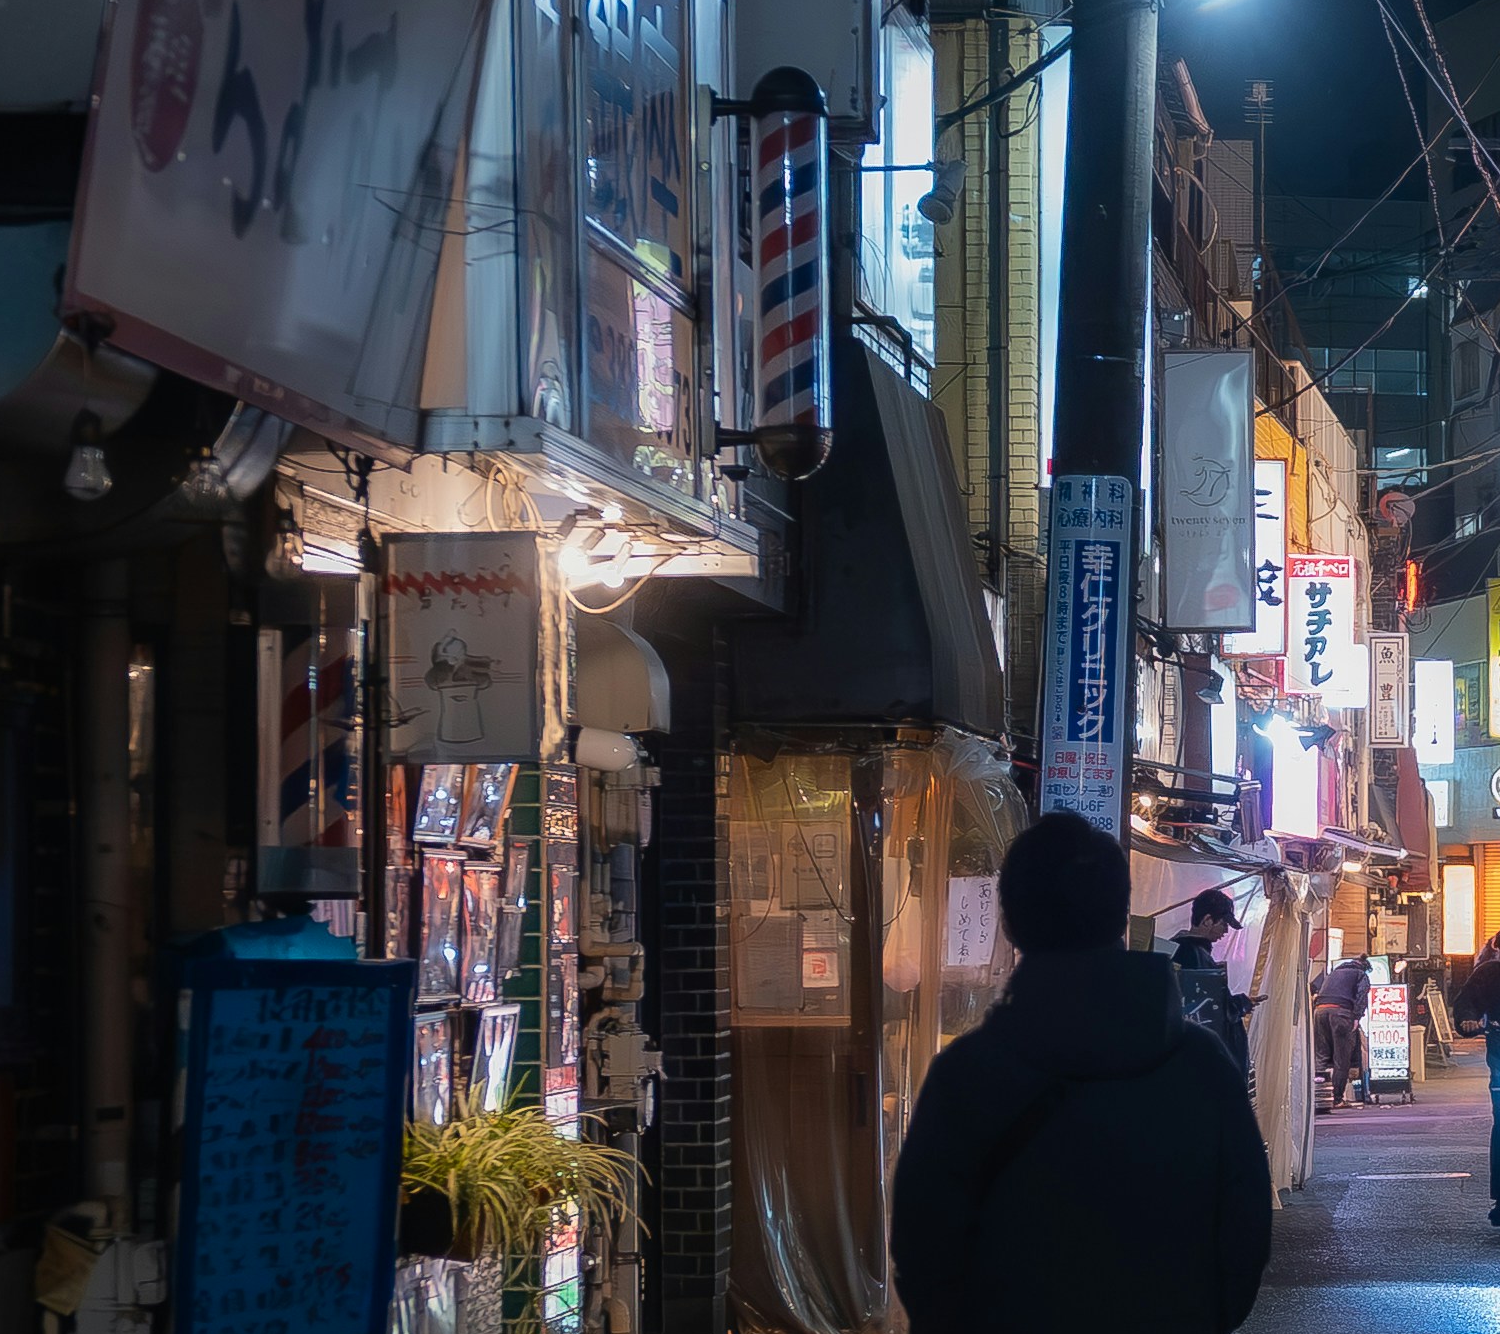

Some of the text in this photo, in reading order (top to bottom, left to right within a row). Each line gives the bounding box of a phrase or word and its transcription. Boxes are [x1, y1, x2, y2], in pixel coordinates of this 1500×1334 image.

[1057, 508, 1124, 529] 心療内科
[1171, 516, 1210, 527] twenty
[1292, 560, 1349, 576] 元祖千ベロ
[1077, 543, 1114, 739] 幸仁クリニック
[1304, 581, 1333, 686] サチアレ
[1055, 752, 1108, 765] 日曜・祝日
[1047, 767, 1115, 781] 診療してます
